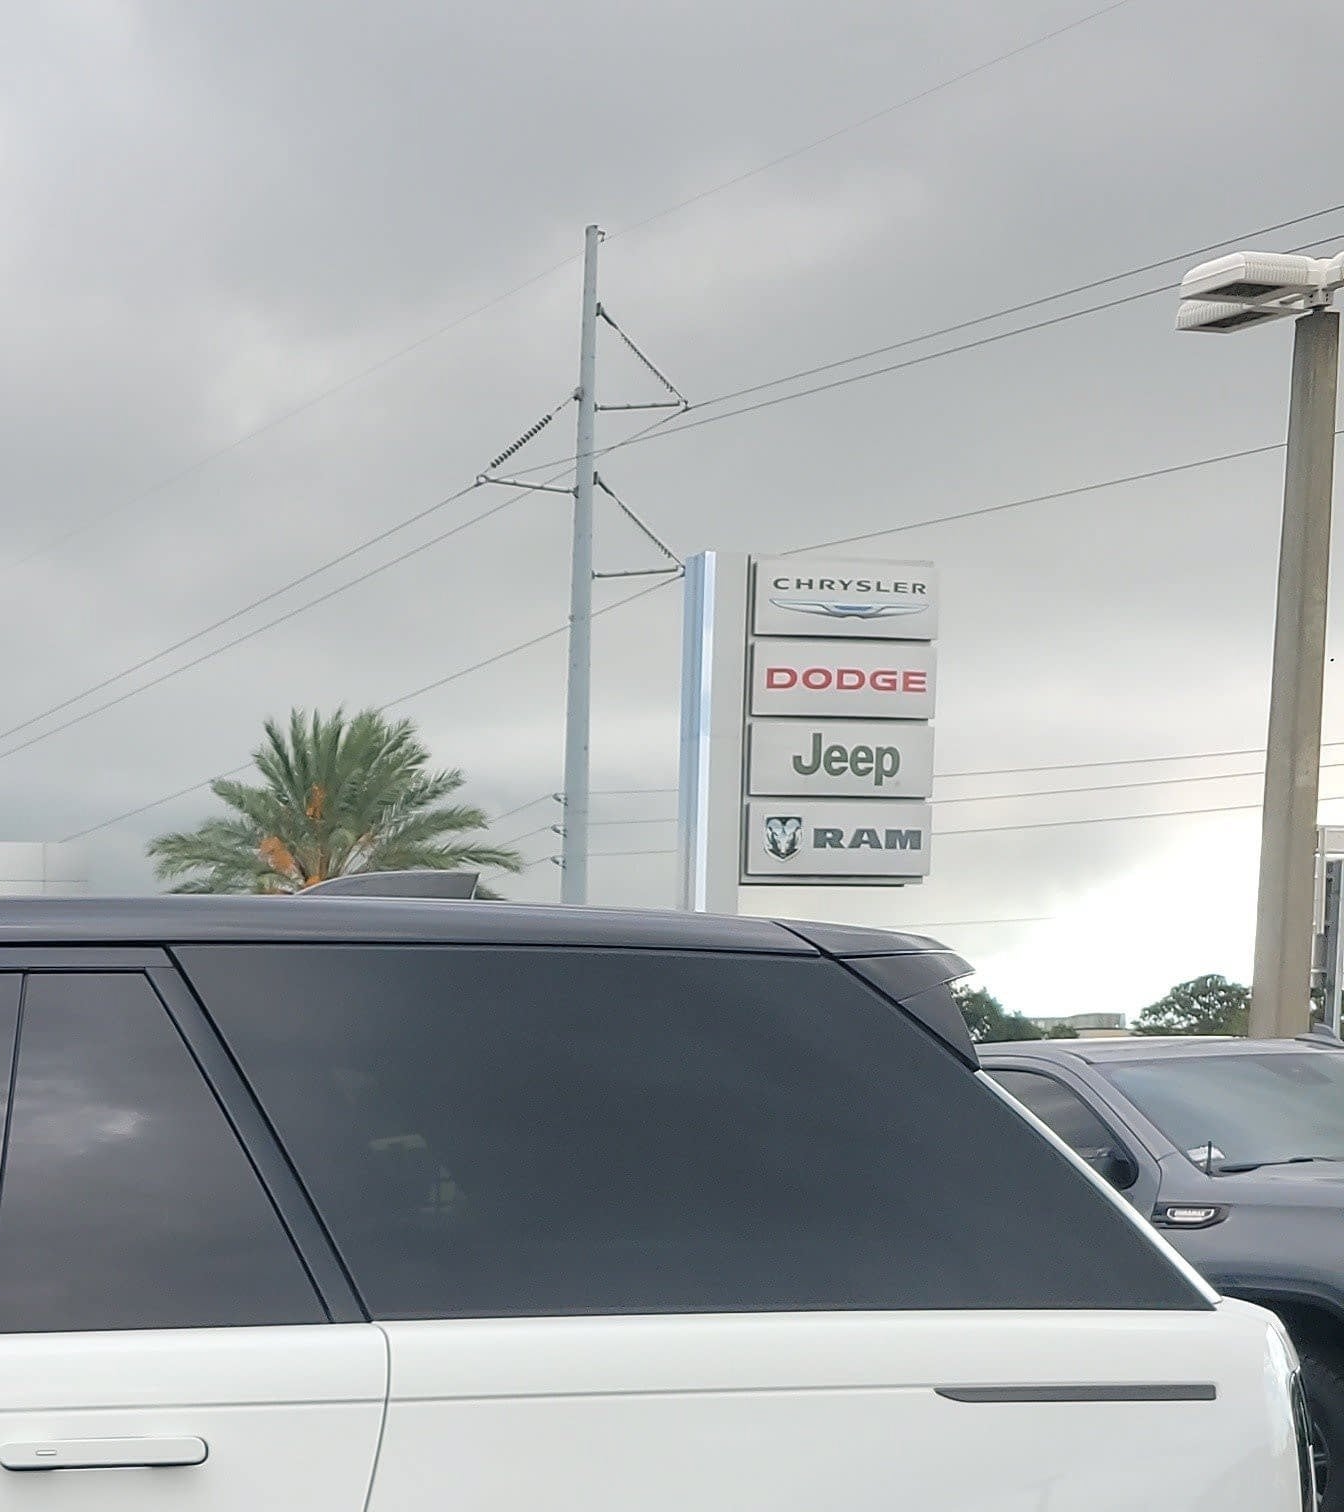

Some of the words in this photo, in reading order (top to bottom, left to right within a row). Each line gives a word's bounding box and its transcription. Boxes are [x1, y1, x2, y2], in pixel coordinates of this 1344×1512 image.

[773, 577, 927, 595] CHRYSLER
[766, 667, 927, 693] DODGE
[793, 732, 901, 786] Jeep
[813, 827, 922, 851] RAM
